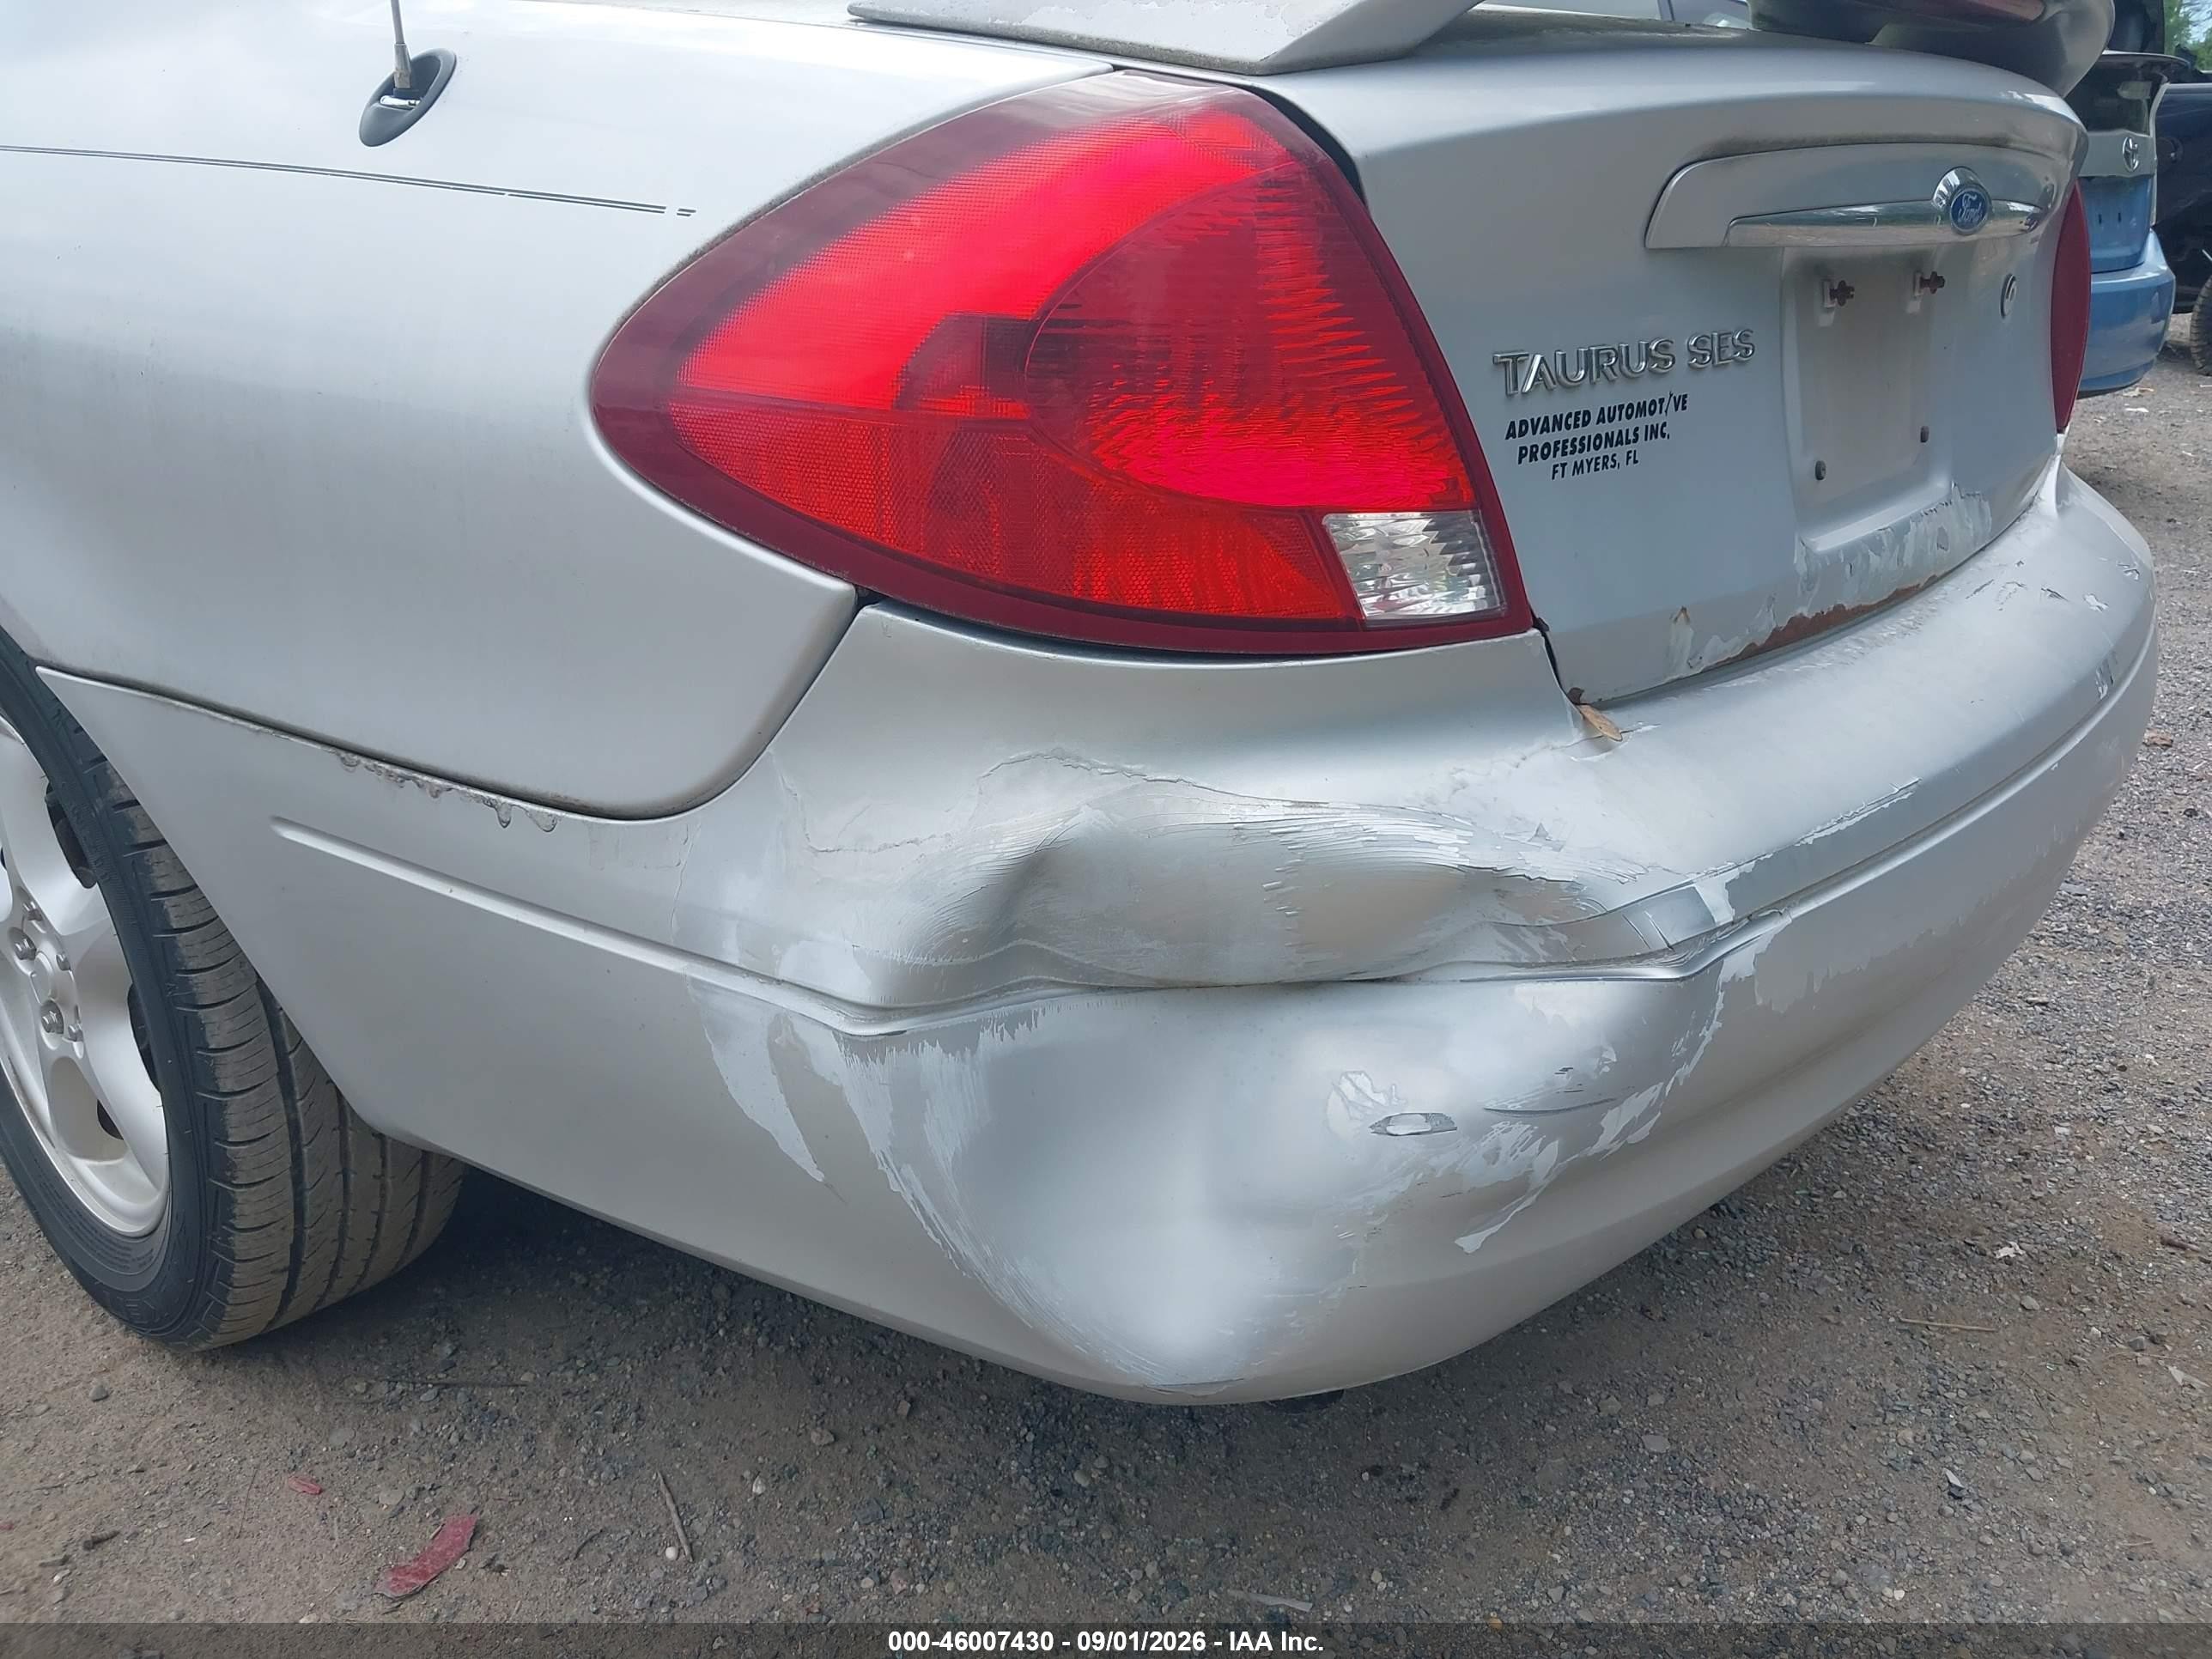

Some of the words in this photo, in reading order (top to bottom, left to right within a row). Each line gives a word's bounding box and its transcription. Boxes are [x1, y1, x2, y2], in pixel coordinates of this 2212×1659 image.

[1957, 192, 1984, 222] Ford
[1492, 337, 1675, 397] TAURUS
[1686, 328, 1756, 370] SES
[1504, 409, 1592, 440] ADVANCED
[1517, 426, 1639, 465] PROFESSIONALS
[1644, 421, 1670, 441] INC.
[1552, 462, 1568, 480] FT
[1571, 453, 1620, 477] MYERS,
[1626, 449, 1639, 466] FL
